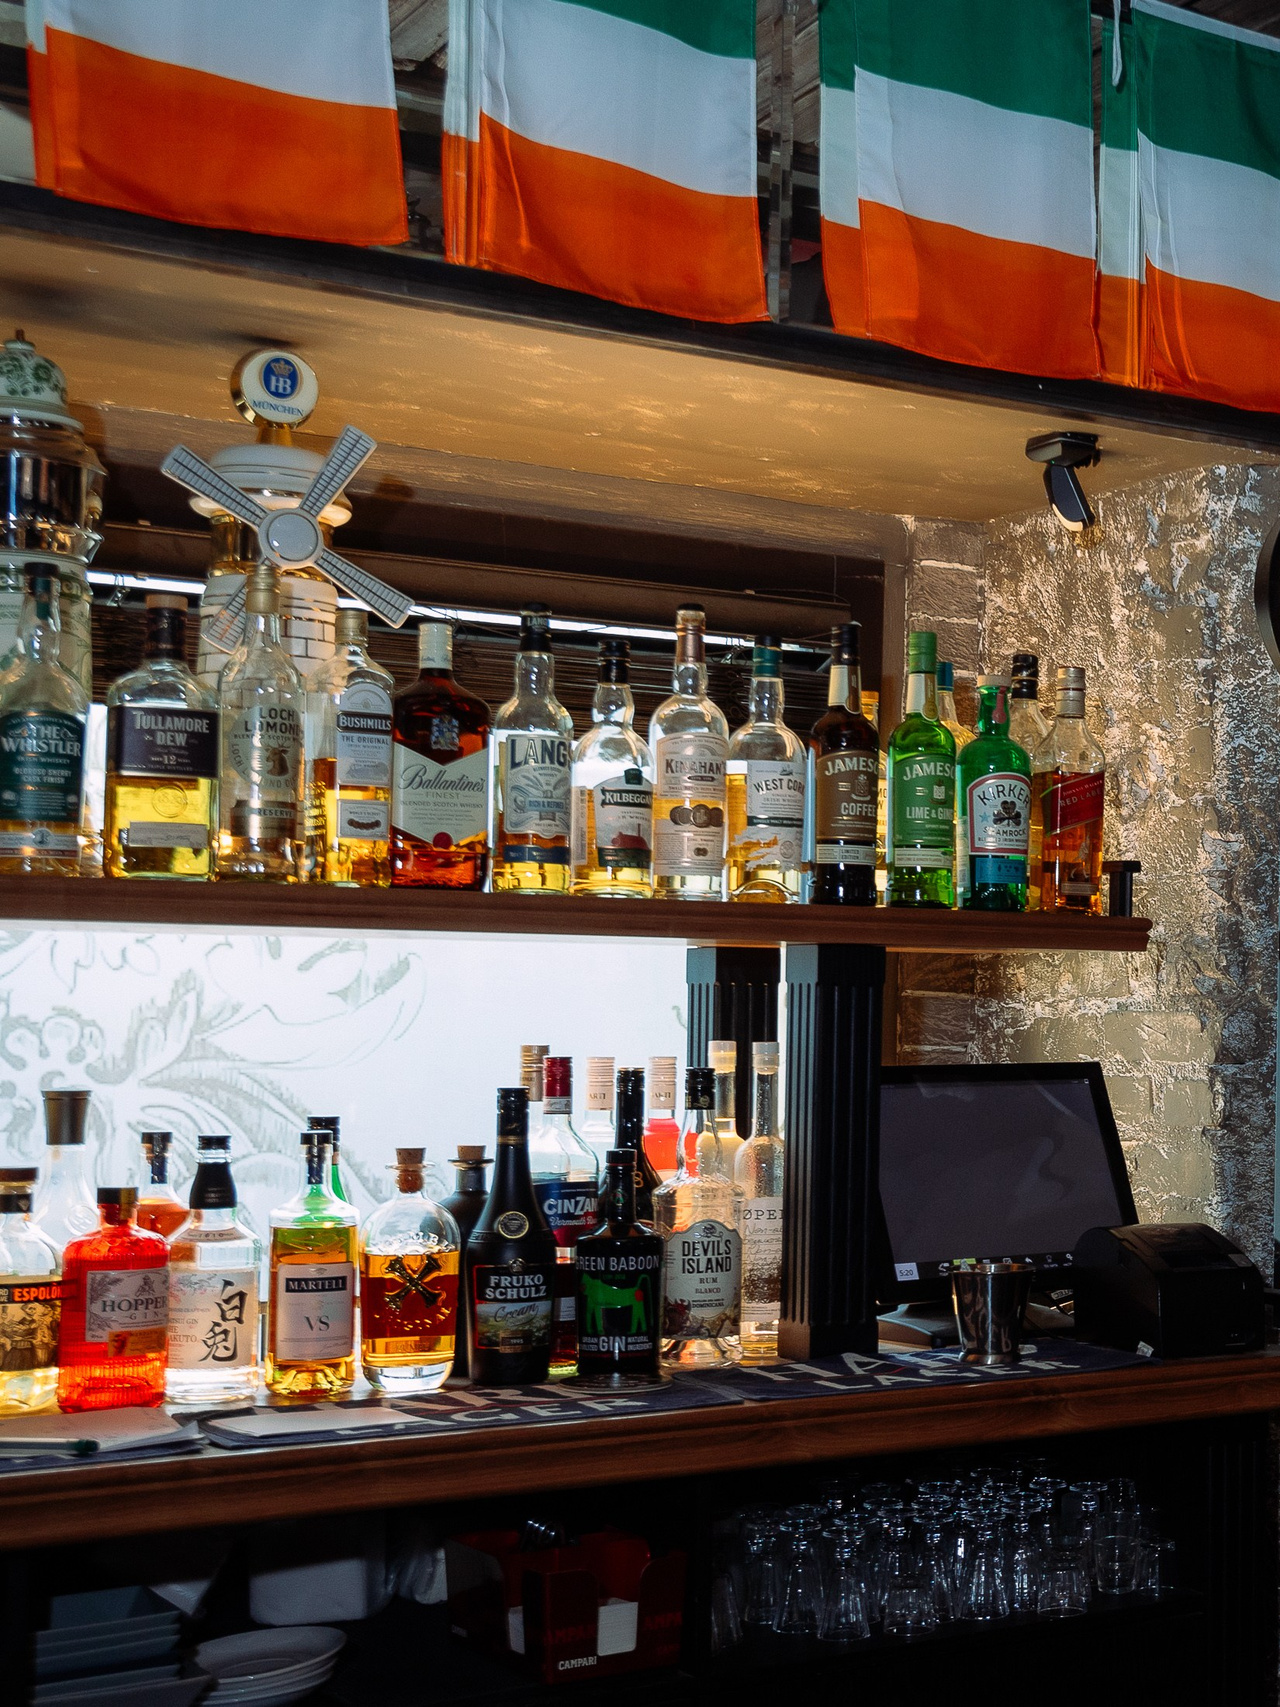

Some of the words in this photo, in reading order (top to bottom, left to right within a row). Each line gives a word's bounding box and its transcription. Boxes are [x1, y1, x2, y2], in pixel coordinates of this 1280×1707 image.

[270, 374, 292, 395] HB
[131, 709, 210, 734] TULLAMORE
[259, 707, 296, 721] LOCH
[339, 715, 392, 731] BUSHMILLS
[0, 735, 82, 757] WHISTLER
[341, 734, 355, 743] THE
[357, 735, 390, 746] ORIGINAL
[162, 754, 177, 765] 12
[399, 763, 486, 795] Ballantine's
[753, 778, 784, 795] WEST
[425, 791, 460, 800] FINEST
[432, 800, 459, 808] SCOTCH
[841, 802, 877, 817] COFFEE
[257, 807, 293, 818] RESERVE
[906, 806, 930, 818] LIME
[931, 809, 937, 818] &
[937, 809, 954, 820] GIN
[588, 1092, 606, 1100] ARTI
[543, 1196, 600, 1215] CINZAN
[550, 1216, 586, 1226] Vermouth
[681, 1240, 732, 1257] DEVILS
[576, 1255, 606, 1271] GREEN
[609, 1254, 660, 1272] BABOON
[681, 1256, 732, 1274] ISLAND
[288, 1278, 344, 1291] MARTELL
[490, 1273, 544, 1287] FRUKO
[485, 1285, 547, 1300] SCHULZ
[494, 1303, 540, 1322] Cream
[304, 1315, 330, 1332] VS
[168, 1334, 198, 1343] AKUTO
[599, 1335, 626, 1352] GIN
[557, 1656, 598, 1671] CAMPARI
